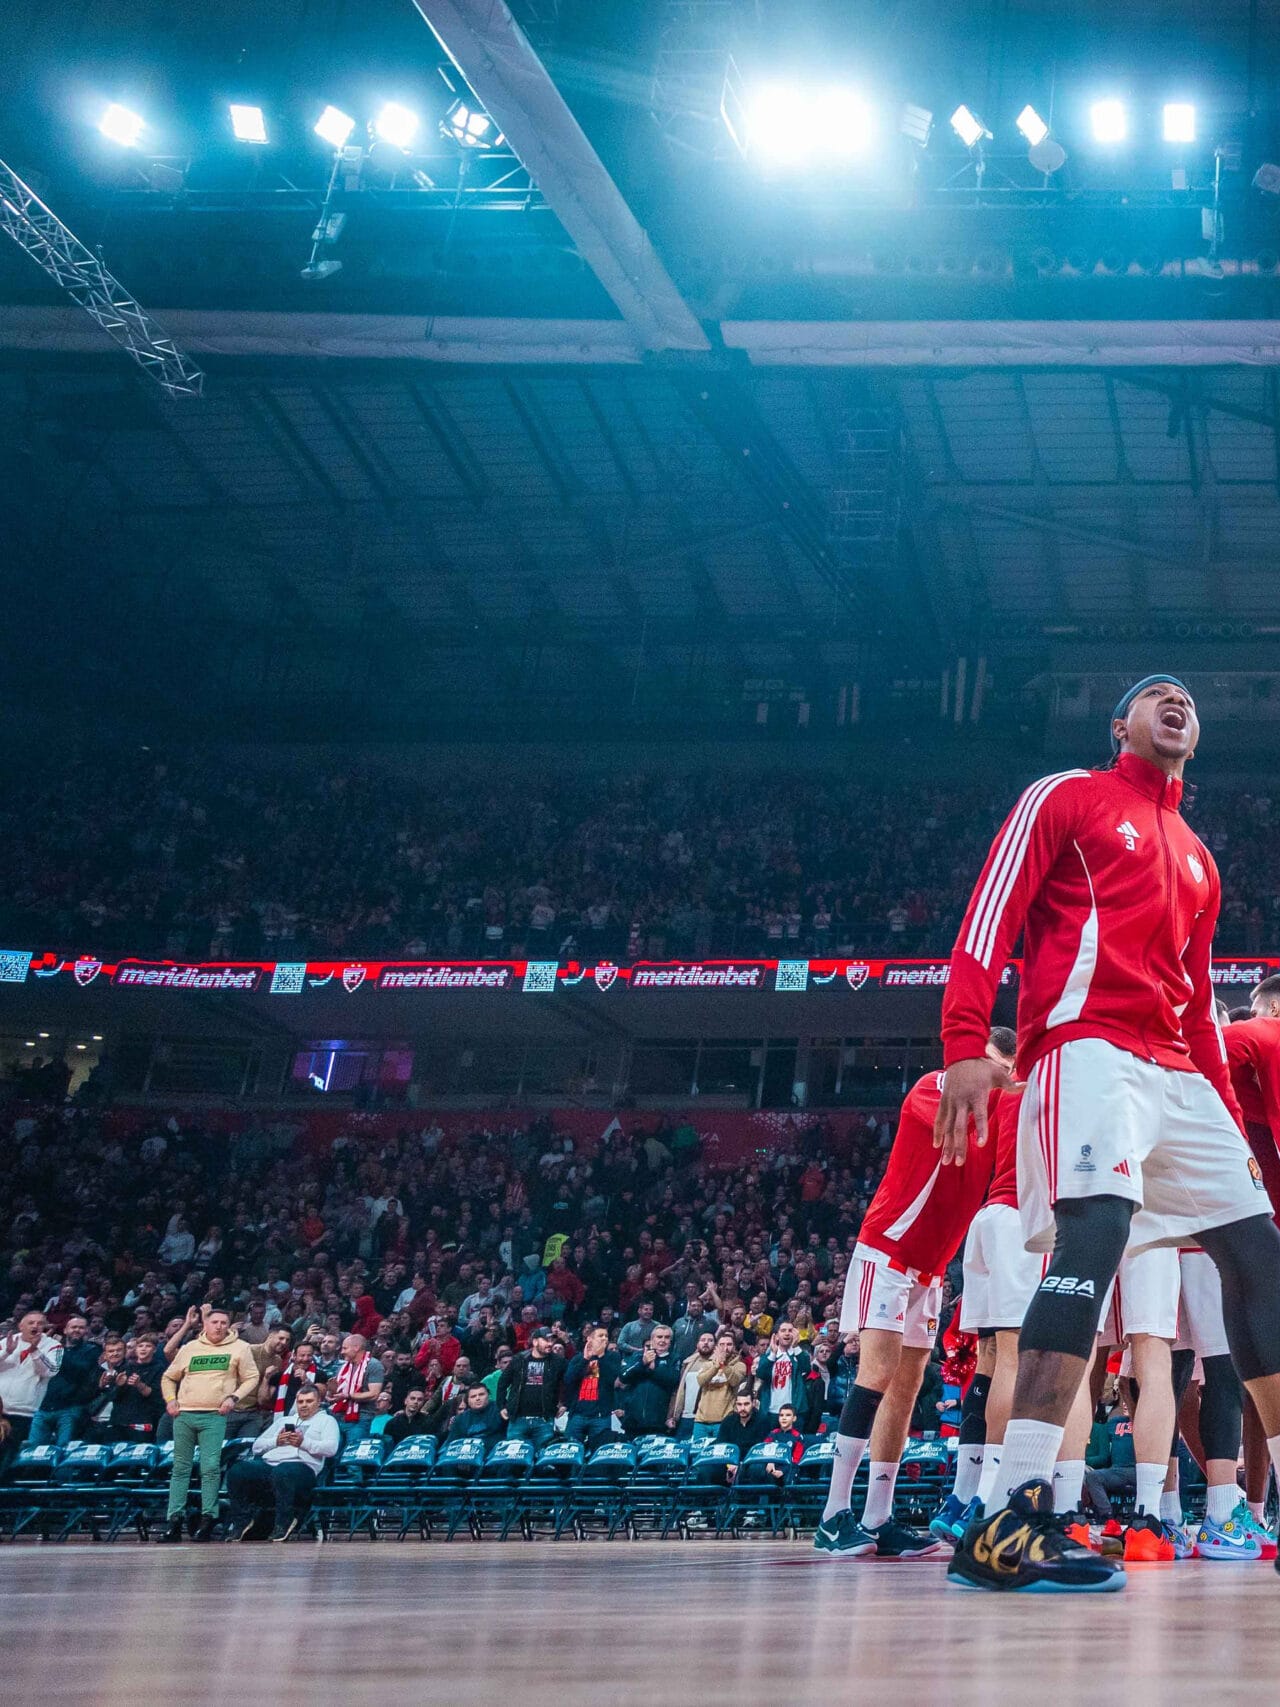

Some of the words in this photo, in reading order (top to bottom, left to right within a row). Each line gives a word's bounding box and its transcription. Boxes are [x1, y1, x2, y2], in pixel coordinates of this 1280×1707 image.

[1125, 835, 1135, 851] 3
[118, 967, 256, 988] meridianbet
[380, 967, 508, 987] meridianbet
[633, 966, 760, 986] meridianbet
[1041, 1276, 1095, 1295] GSA
[193, 1357, 227, 1365] KENZO
